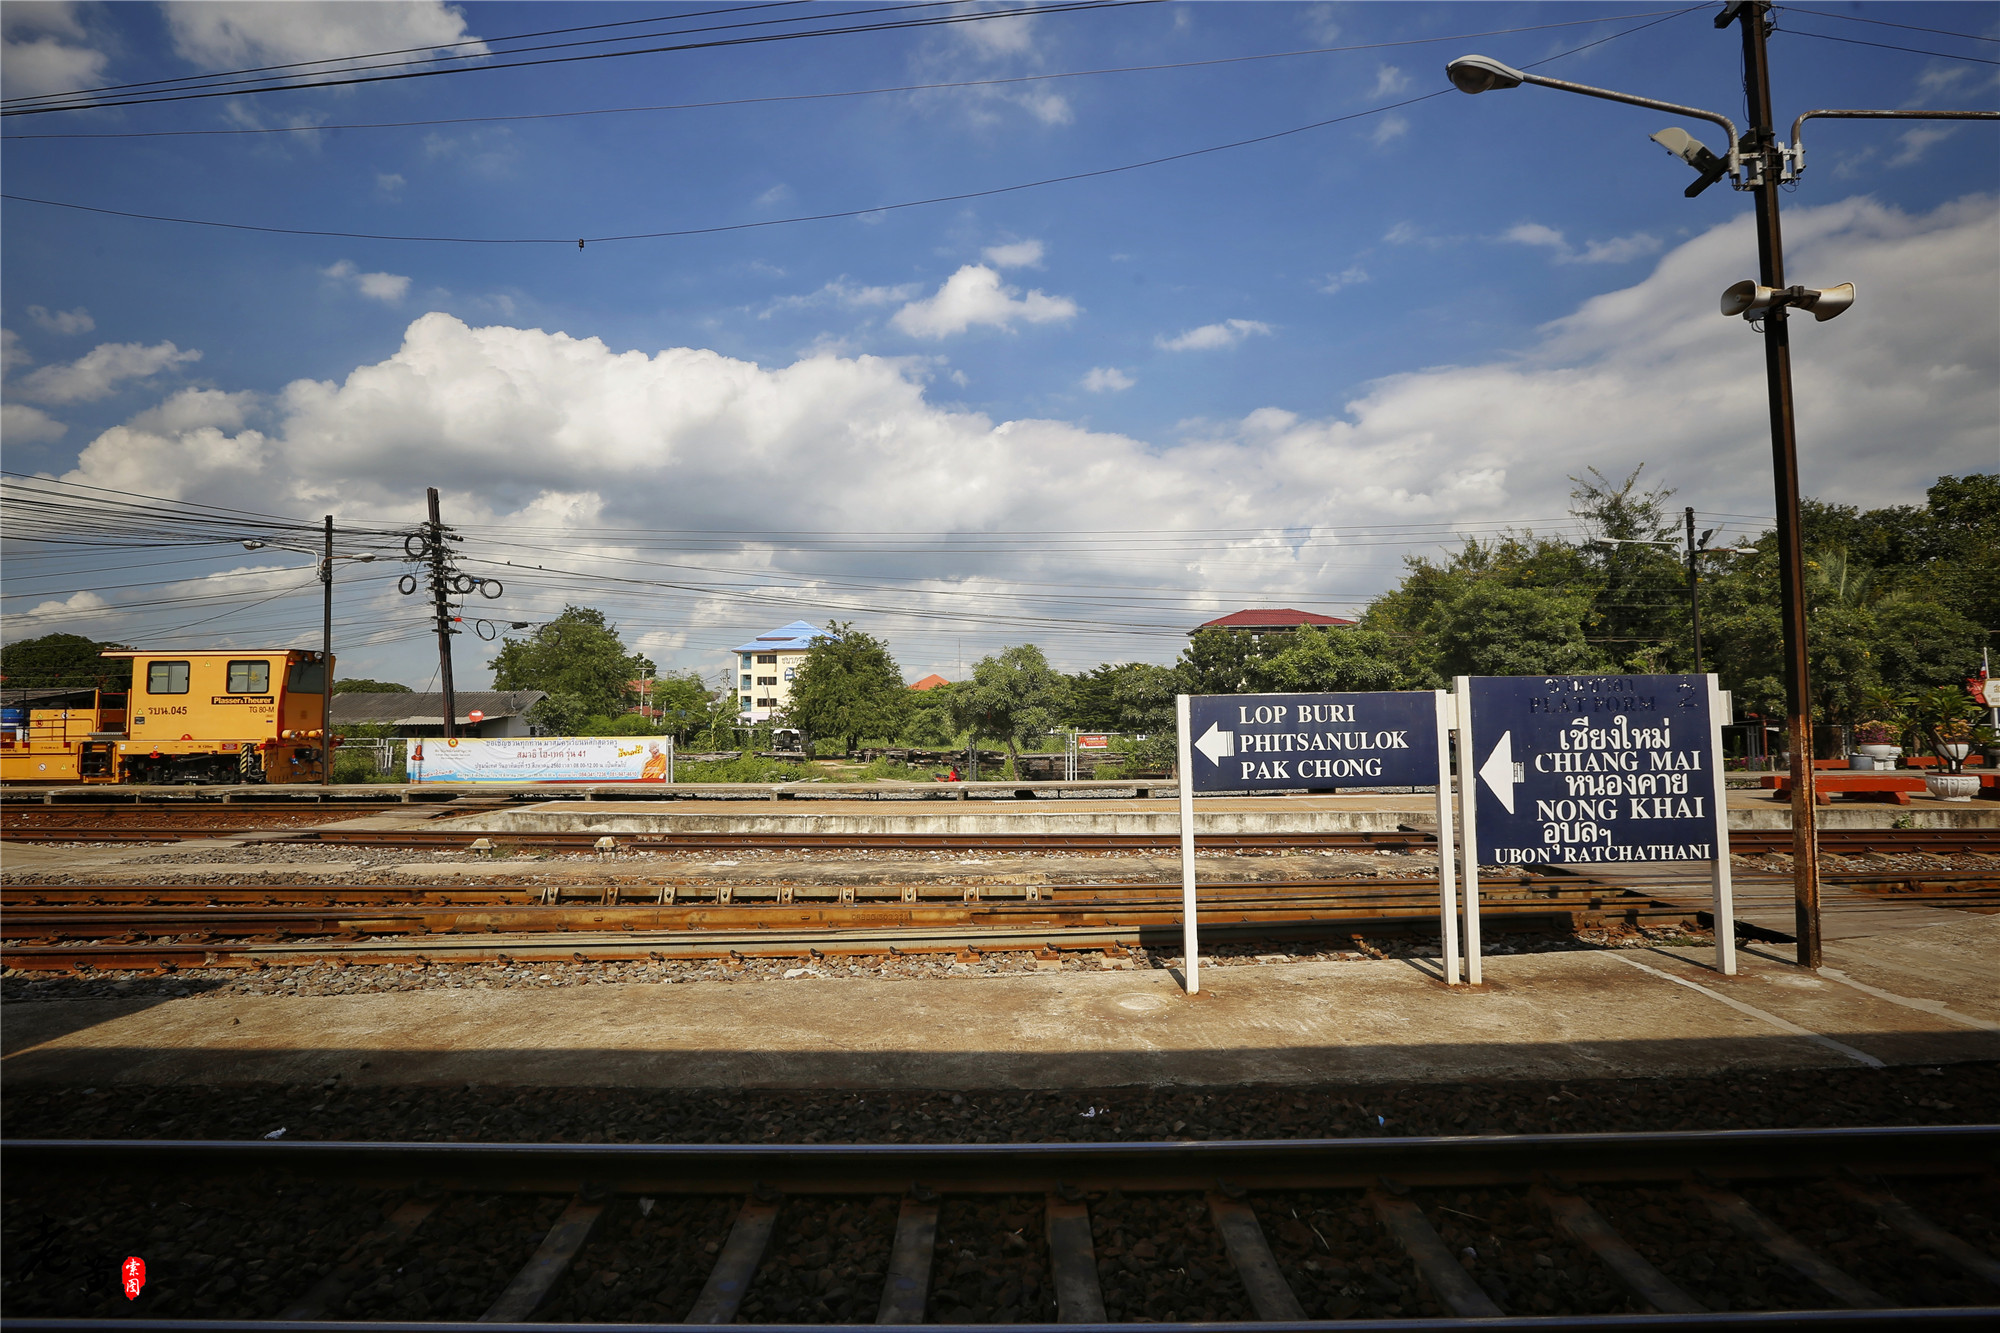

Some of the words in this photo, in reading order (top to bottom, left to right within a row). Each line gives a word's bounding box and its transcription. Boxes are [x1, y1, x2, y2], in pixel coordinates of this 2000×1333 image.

[148, 706, 188, 715] รบน.045
[1239, 705, 1288, 725] LOP
[1297, 704, 1356, 724] BURI
[1529, 696, 1657, 714] PLATFORM
[1239, 730, 1410, 753] PHITSANULOK
[1560, 714, 1671, 751] เชียงใหม่
[577, 750, 586, 758] 41
[1535, 751, 1639, 774] CHIANG
[1649, 750, 1702, 772] MAI
[1241, 760, 1291, 780] PAK
[1297, 758, 1383, 778] CHONG
[1565, 773, 1689, 797] หนองคาย
[1536, 798, 1618, 822] NONG
[1629, 797, 1706, 820] KHAI
[1543, 821, 1612, 855] อุบลฯ
[1494, 847, 1551, 864] UBON
[1563, 843, 1711, 863] RATCHATHANI
